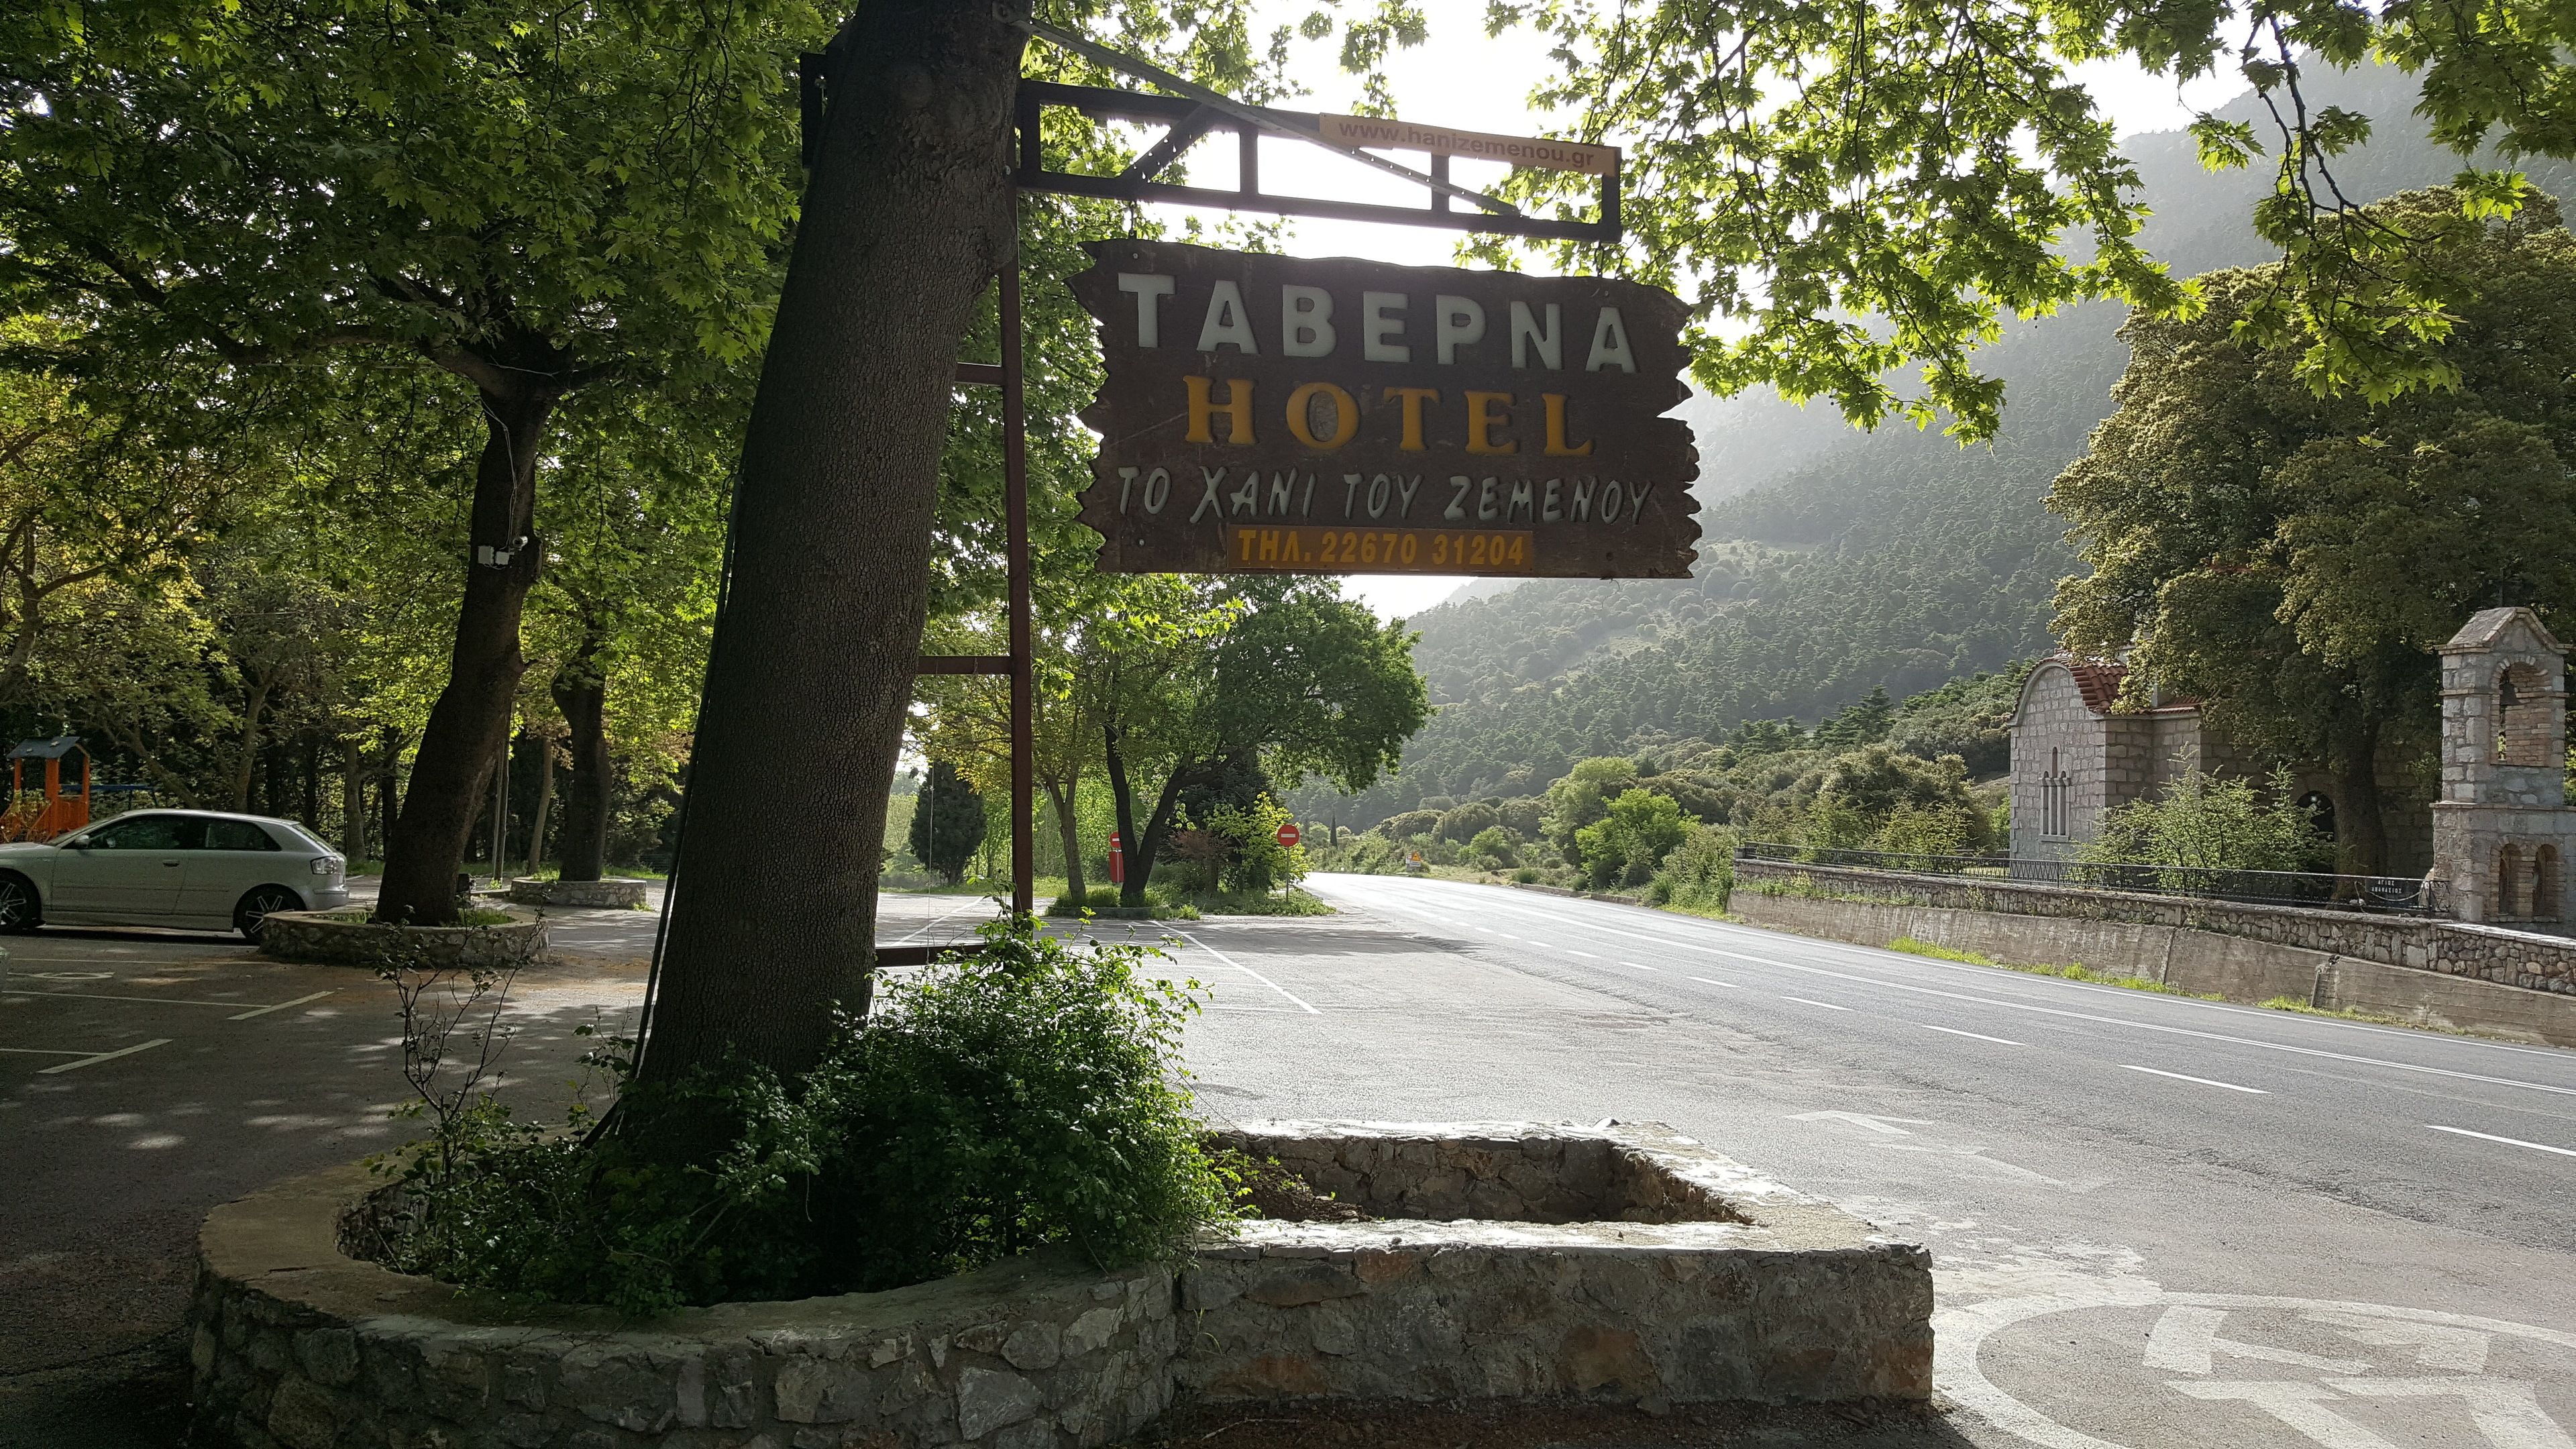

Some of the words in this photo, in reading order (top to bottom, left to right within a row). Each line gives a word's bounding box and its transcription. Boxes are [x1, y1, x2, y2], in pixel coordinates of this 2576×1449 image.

[1339, 120, 1594, 168] www.hanizemenou.gr
[1116, 272, 1639, 374] ΤΑΒΕΡΝΑ
[1182, 374, 1595, 458] HOTEL
[1118, 466, 1172, 516] ΤΟ
[1189, 466, 1318, 524] ΧΑΝΙ
[1343, 472, 1424, 520] ΤΟΥ
[1443, 475, 1656, 525] ΖΕΜΕΝΟΥ
[1238, 529, 1311, 563] ΤΗΛ.
[1321, 532, 1417, 565] 22670
[1432, 534, 1525, 566] 31204
